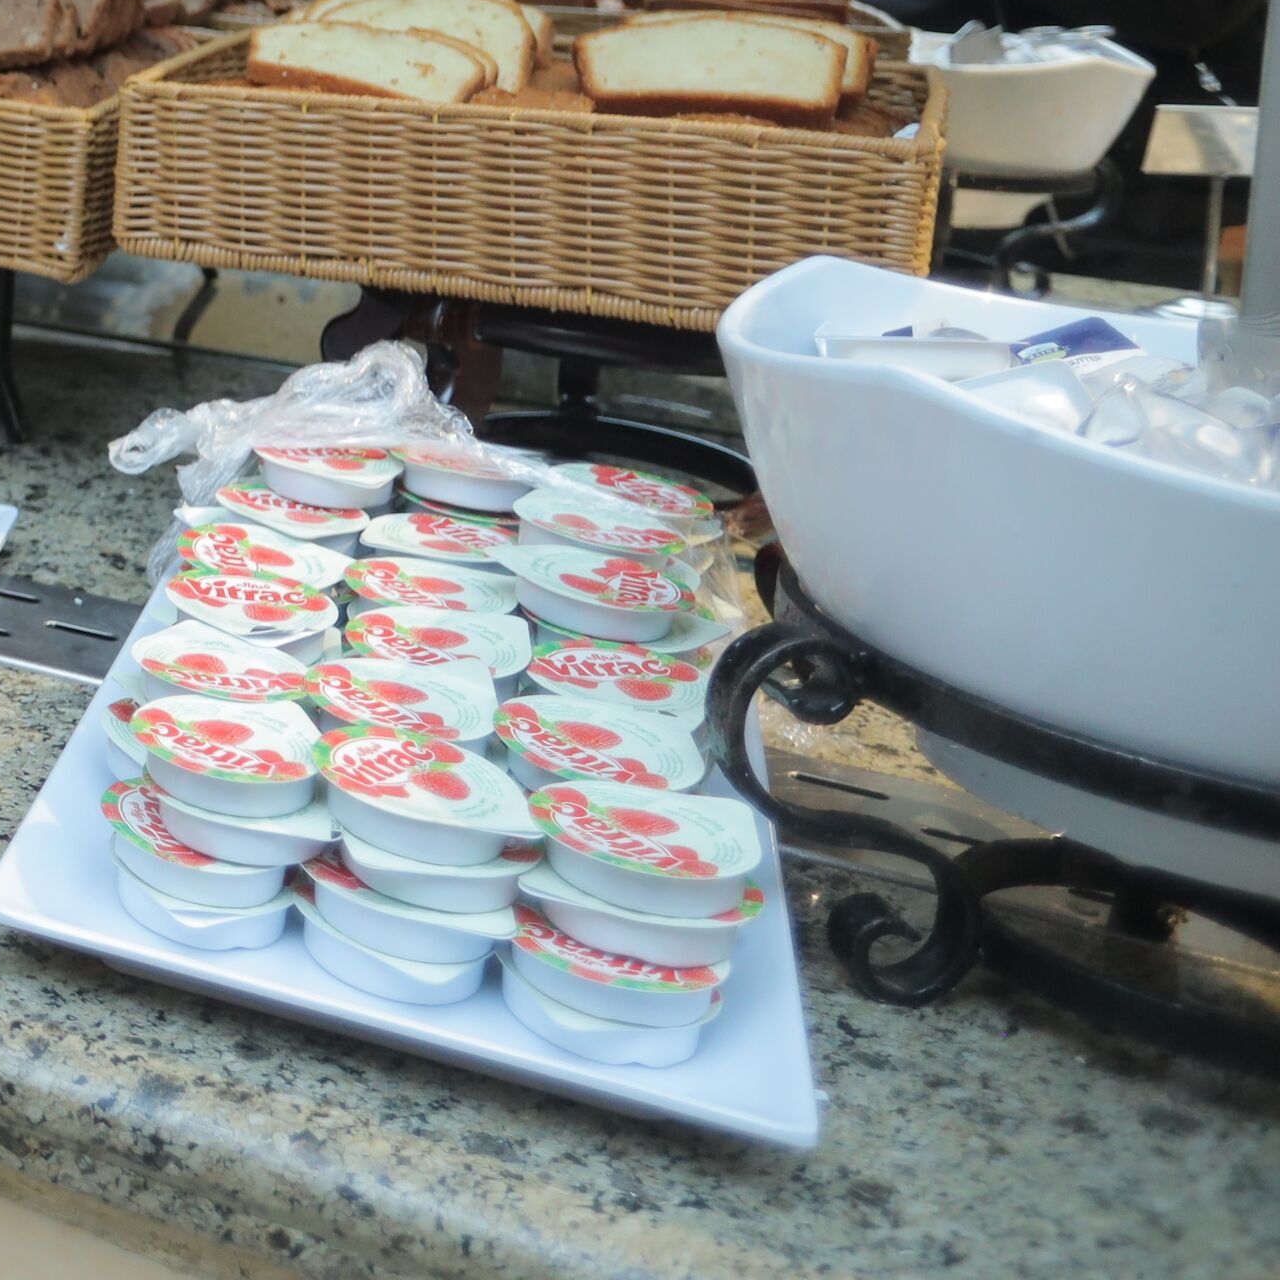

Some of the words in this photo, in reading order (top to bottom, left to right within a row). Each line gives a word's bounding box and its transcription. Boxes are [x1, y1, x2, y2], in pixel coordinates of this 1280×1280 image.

[184, 578, 307, 605] Vitrac
[364, 626, 450, 666] itrac
[534, 653, 671, 678] Vitrac
[166, 668, 301, 693] Vitrac
[319, 676, 431, 733] Vitrac
[149, 722, 275, 777] Vitrac
[329, 738, 435, 786] Vitrac
[507, 718, 635, 783] Vitrac
[550, 802, 683, 870] Vitrac
